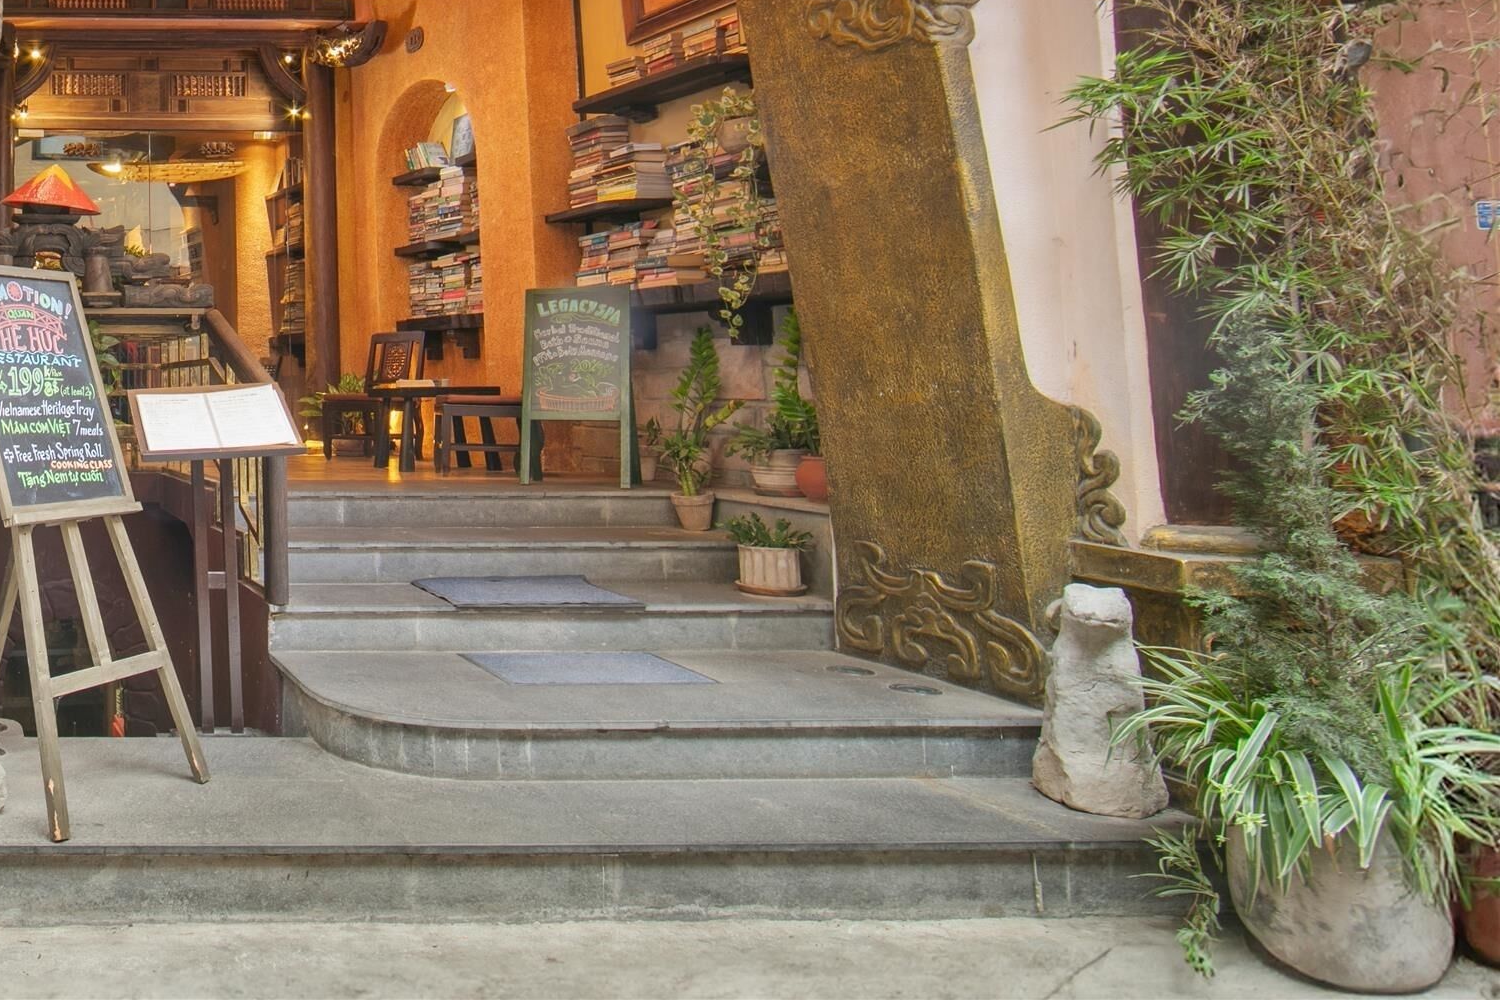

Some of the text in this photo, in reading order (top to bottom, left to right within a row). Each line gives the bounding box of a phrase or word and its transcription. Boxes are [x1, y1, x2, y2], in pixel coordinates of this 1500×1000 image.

[536, 298, 621, 325] LEGACY SPA
[42, 400, 74, 418] Heritage
[73, 400, 95, 422] Tray
[72, 419, 81, 436] 7
[80, 422, 104, 436] meals
[13, 442, 104, 462] Free Fresh Spring Roll
[50, 459, 113, 471] COOKING CLASS
[44, 469, 68, 484] Nem
